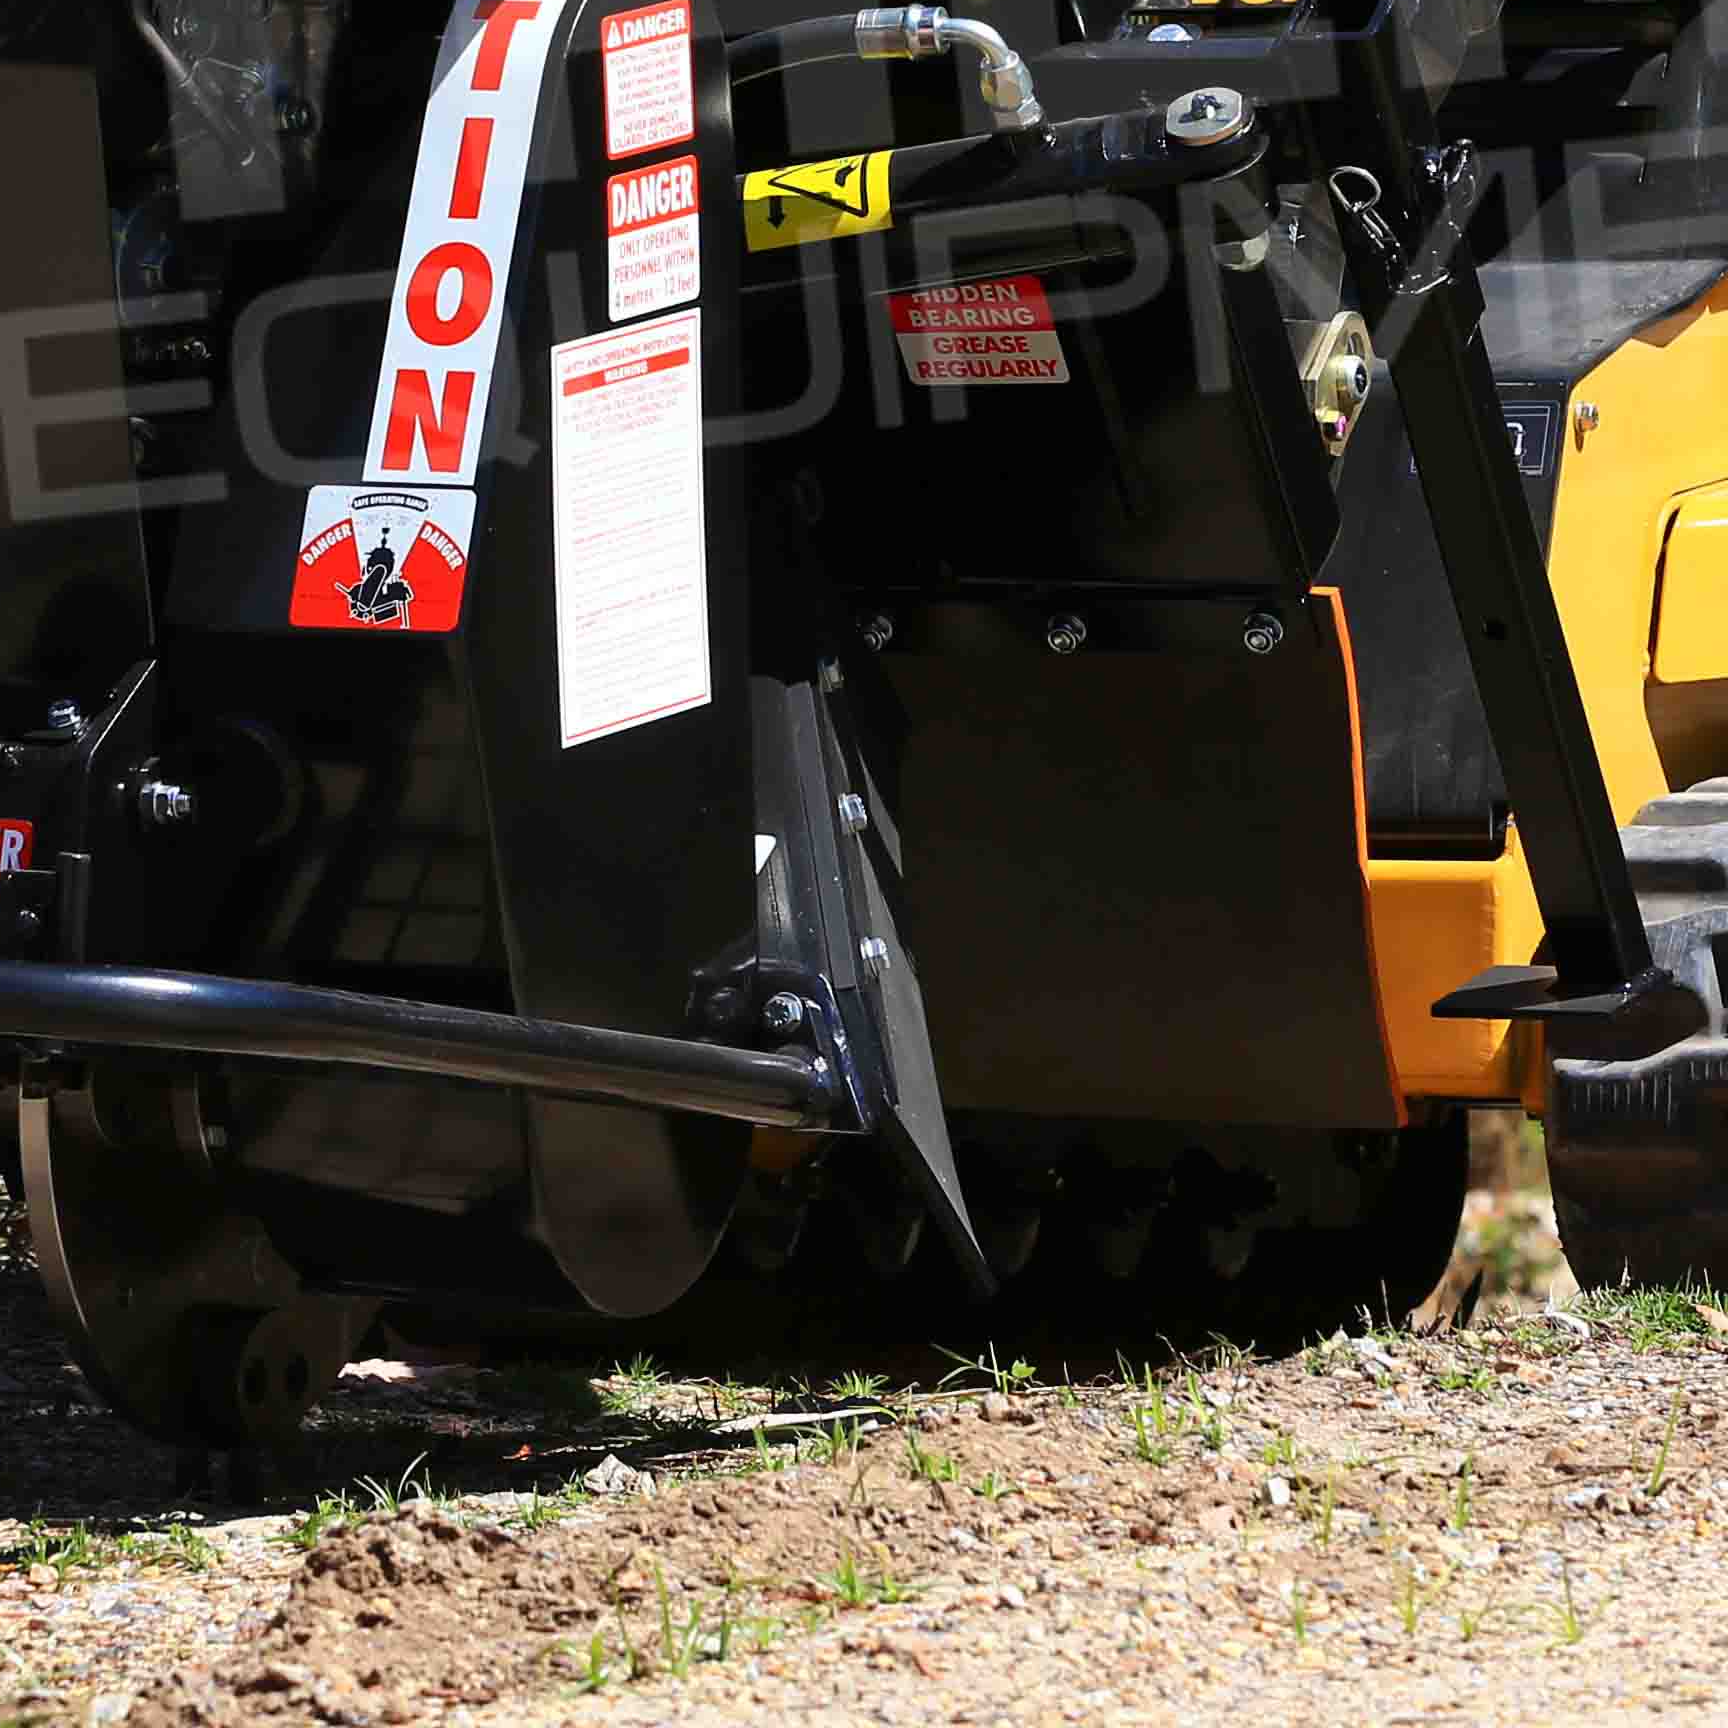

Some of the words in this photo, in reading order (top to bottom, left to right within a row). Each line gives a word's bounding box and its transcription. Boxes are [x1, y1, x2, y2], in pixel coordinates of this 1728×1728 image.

[623, 7, 686, 43] DANGER
[611, 165, 694, 228] DANGER
[643, 223, 690, 251] OPERATING
[614, 257, 663, 286] PERSONNEL
[663, 247, 696, 272] WITHIN
[677, 272, 696, 292] feet
[908, 307, 1036, 328] BEARING
[933, 335, 1031, 354] GREASE
[916, 359, 1057, 379] REGULARLY
[301, 523, 353, 567] DANGER
[419, 524, 464, 572] DANGER
